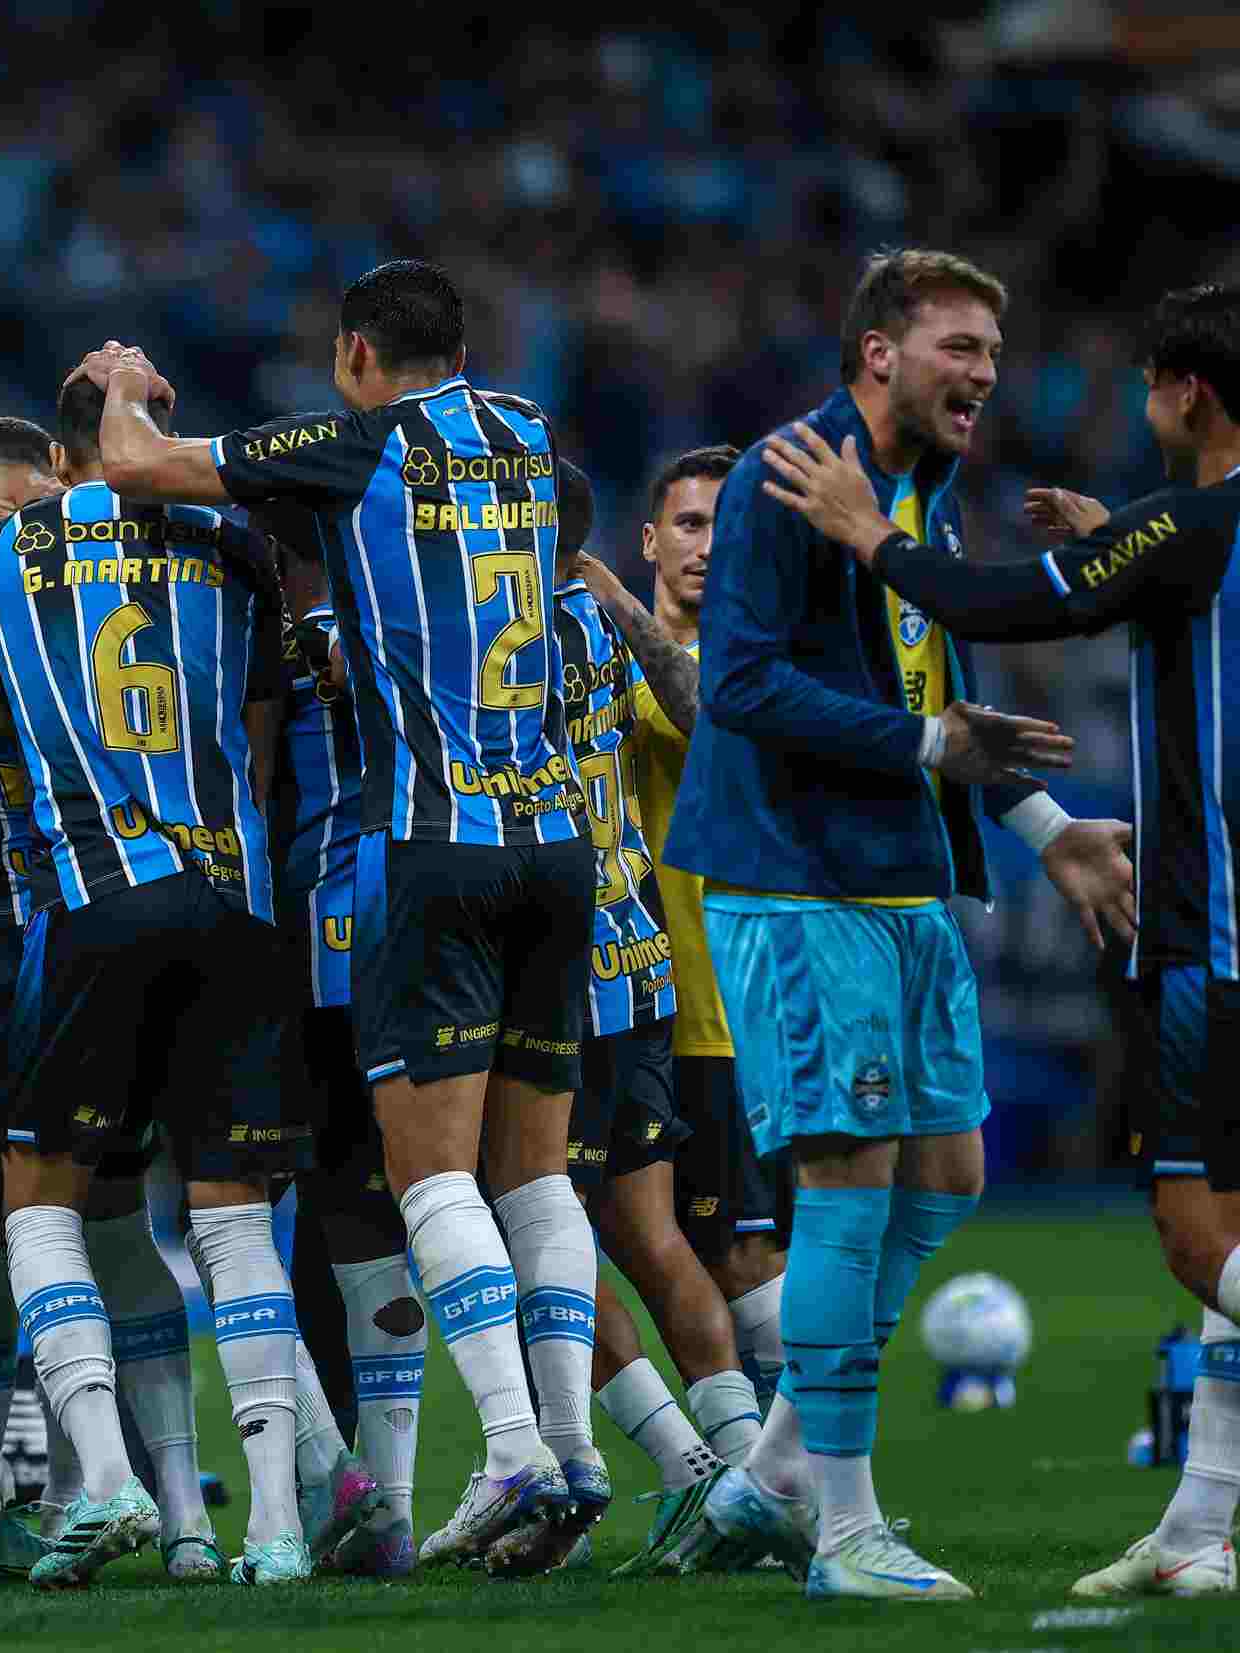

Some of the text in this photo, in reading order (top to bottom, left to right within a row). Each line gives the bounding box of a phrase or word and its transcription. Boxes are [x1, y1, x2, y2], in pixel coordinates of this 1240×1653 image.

[245, 420, 339, 463] HAVAN
[446, 452, 553, 482] banrisu
[414, 501, 558, 530] BALBUEN
[1080, 511, 1178, 590] HAVAN
[23, 558, 225, 595] G. MARTINS
[471, 550, 544, 710] 2
[91, 600, 181, 754] 6
[450, 754, 571, 798] Unime
[590, 929, 673, 982] Unime
[458, 1023, 499, 1043] INGRES
[524, 1038, 583, 1057] INGRESSE
[443, 1284, 517, 1321] GFBP
[358, 1368, 425, 1385] GFBP
